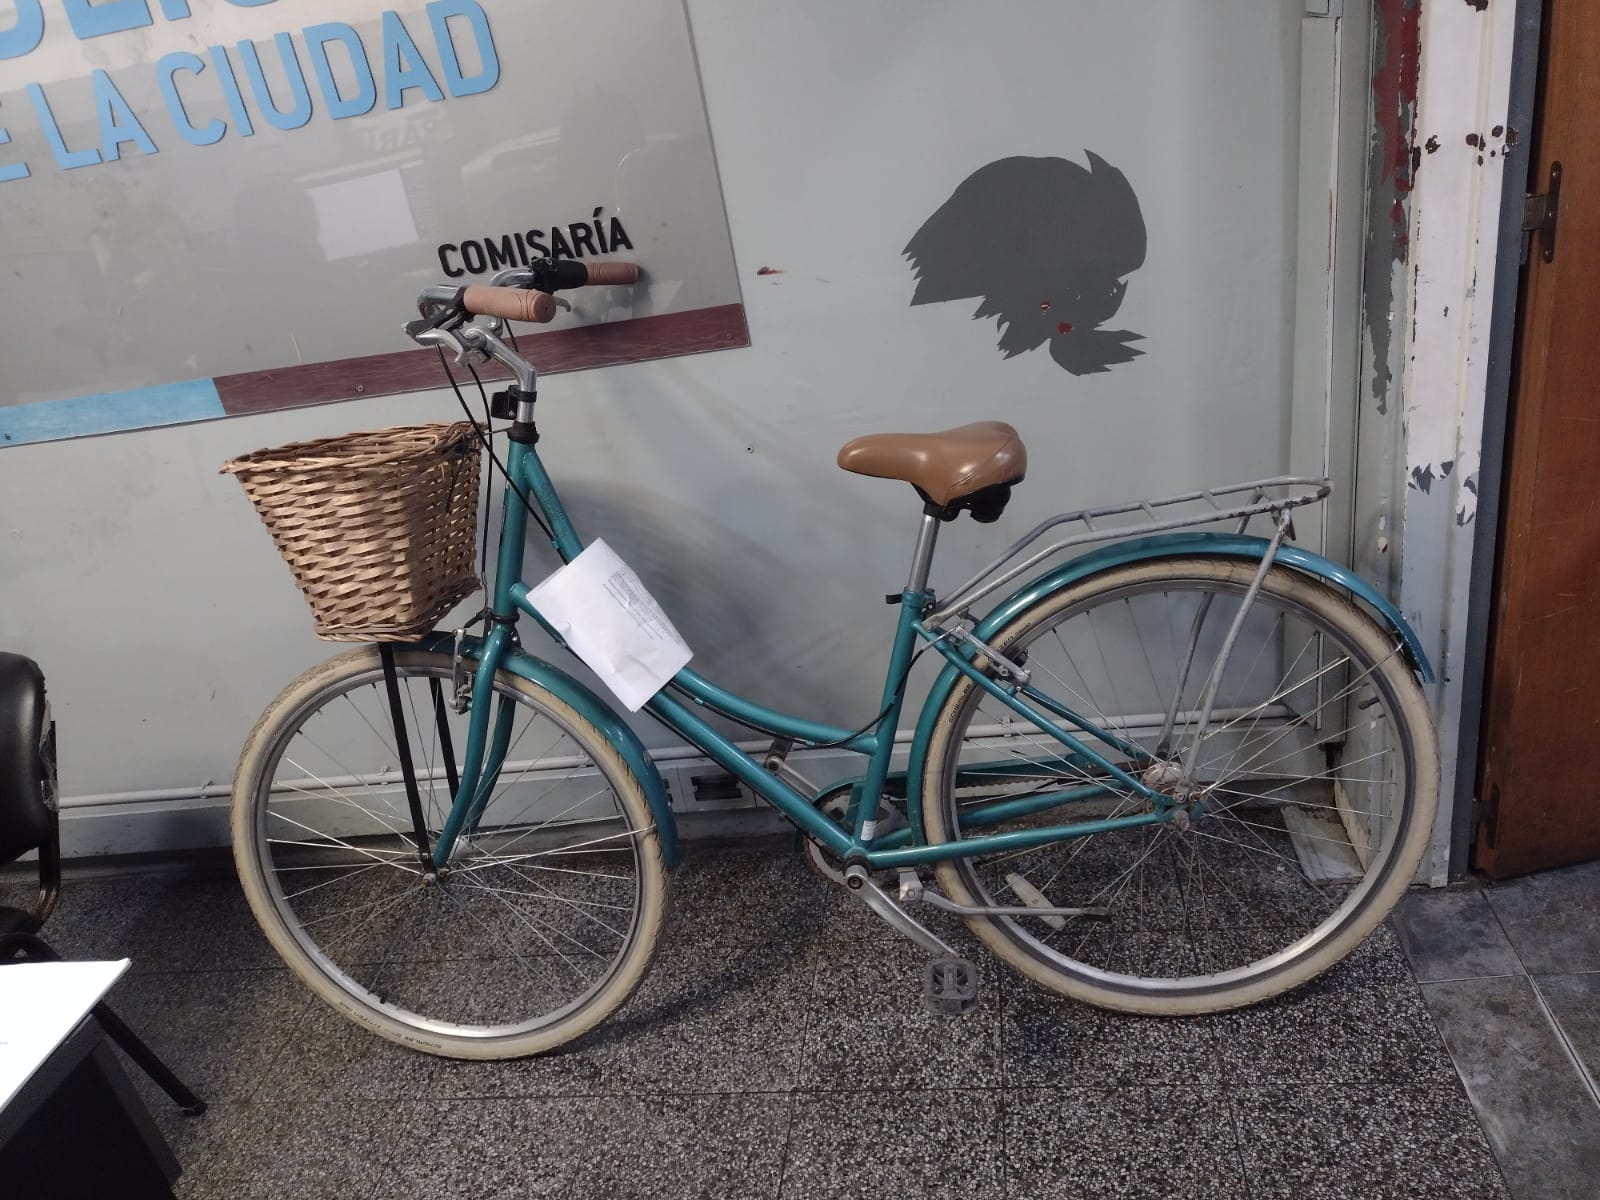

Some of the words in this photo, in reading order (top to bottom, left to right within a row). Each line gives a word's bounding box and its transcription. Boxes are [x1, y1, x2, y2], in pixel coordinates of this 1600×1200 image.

[26, 69, 159, 170] LA
[156, 0, 500, 146] CIUDAD
[437, 207, 633, 278] COMISARÍA
